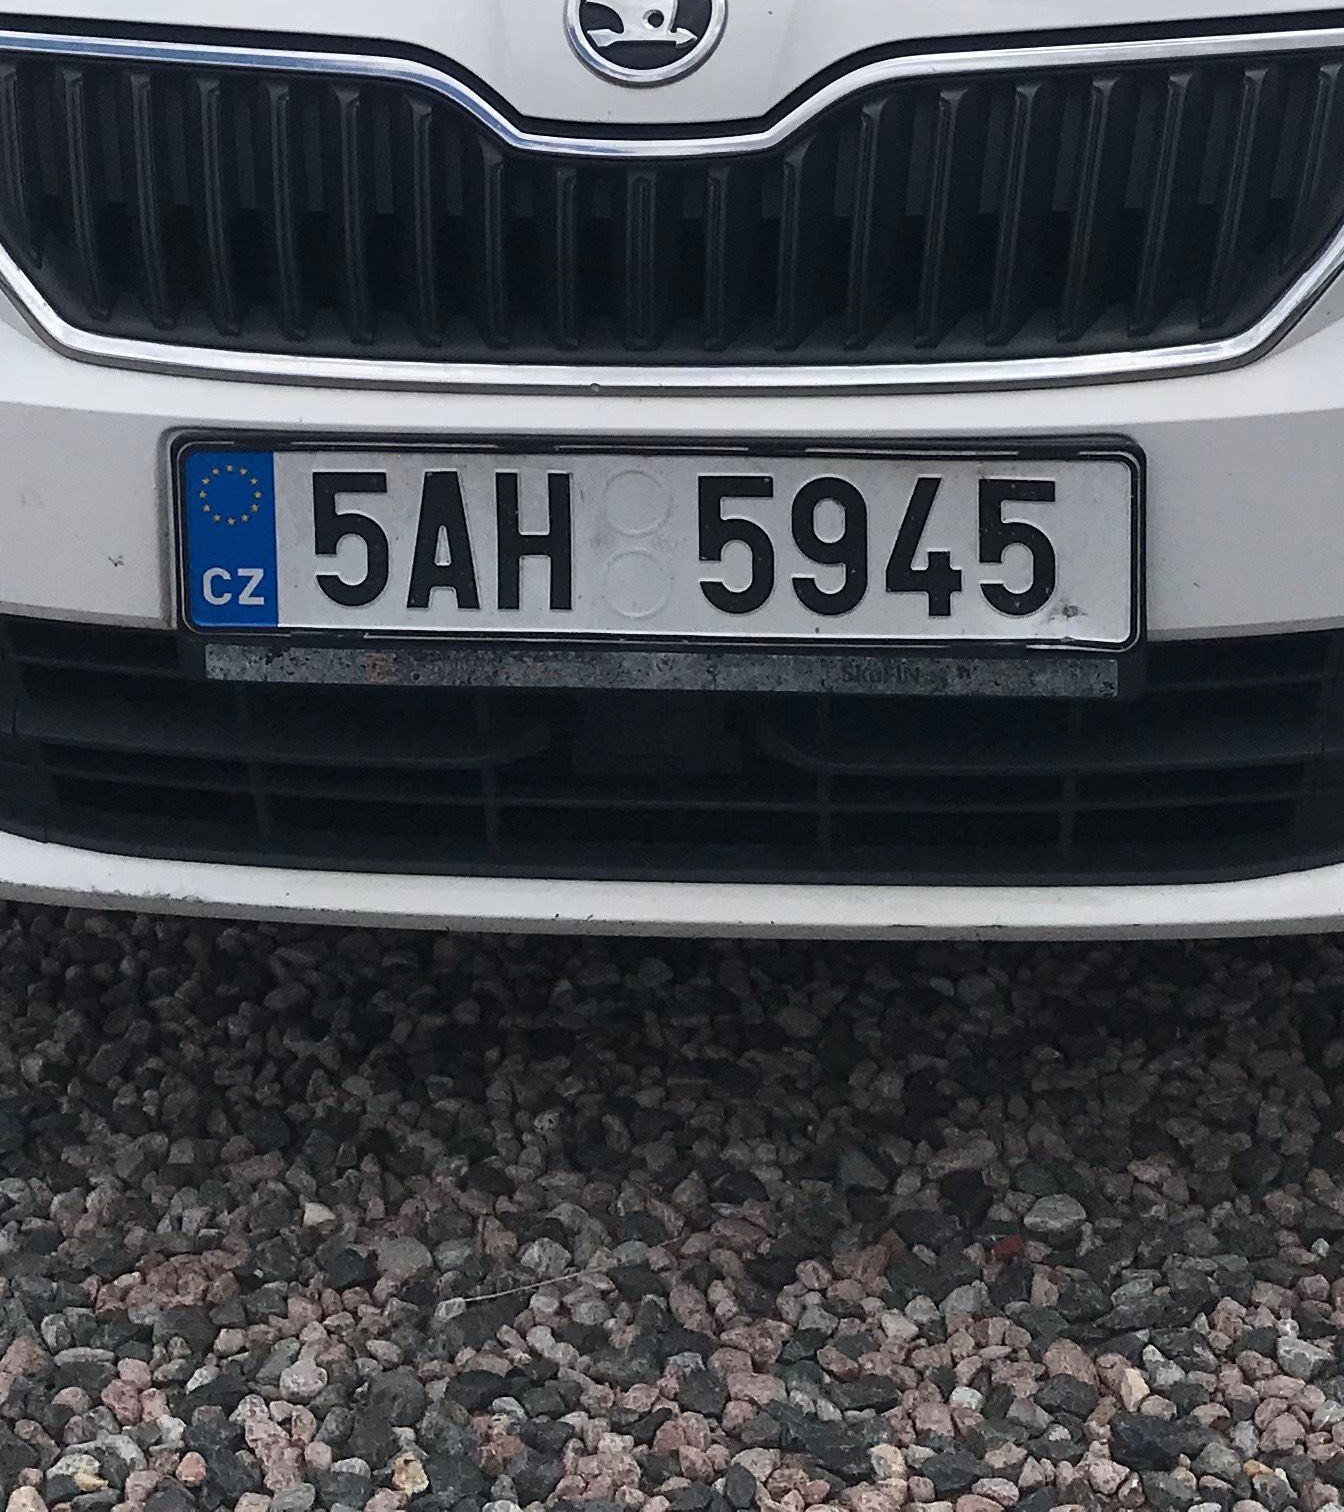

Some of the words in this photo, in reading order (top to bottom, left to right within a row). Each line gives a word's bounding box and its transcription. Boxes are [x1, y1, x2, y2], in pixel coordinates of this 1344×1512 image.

[202, 567, 265, 605] CZ
[313, 471, 573, 612] 5AH
[698, 475, 1057, 618] 5945
